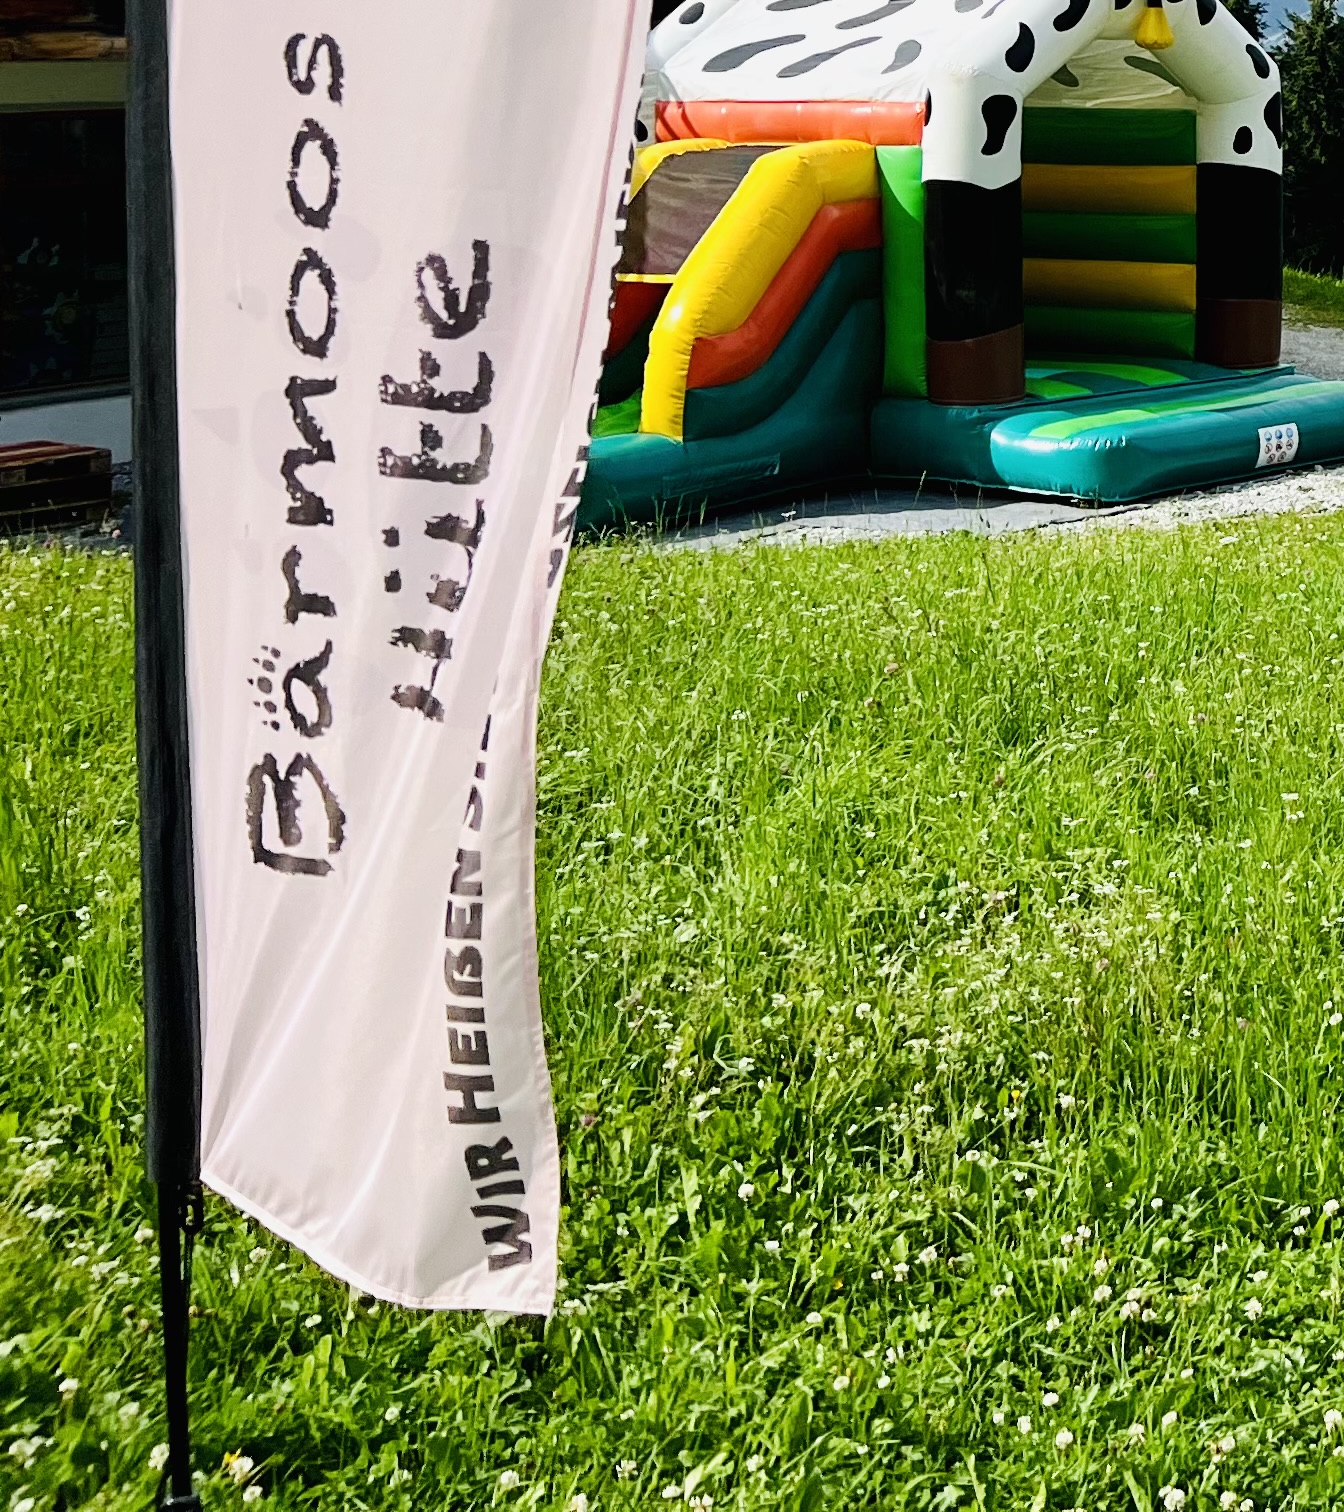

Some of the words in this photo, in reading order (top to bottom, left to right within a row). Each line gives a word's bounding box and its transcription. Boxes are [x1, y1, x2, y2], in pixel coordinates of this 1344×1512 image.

[245, 33, 346, 876] Bärmoos
[378, 239, 493, 722] Hütte
[464, 1136, 532, 1272] WIR
